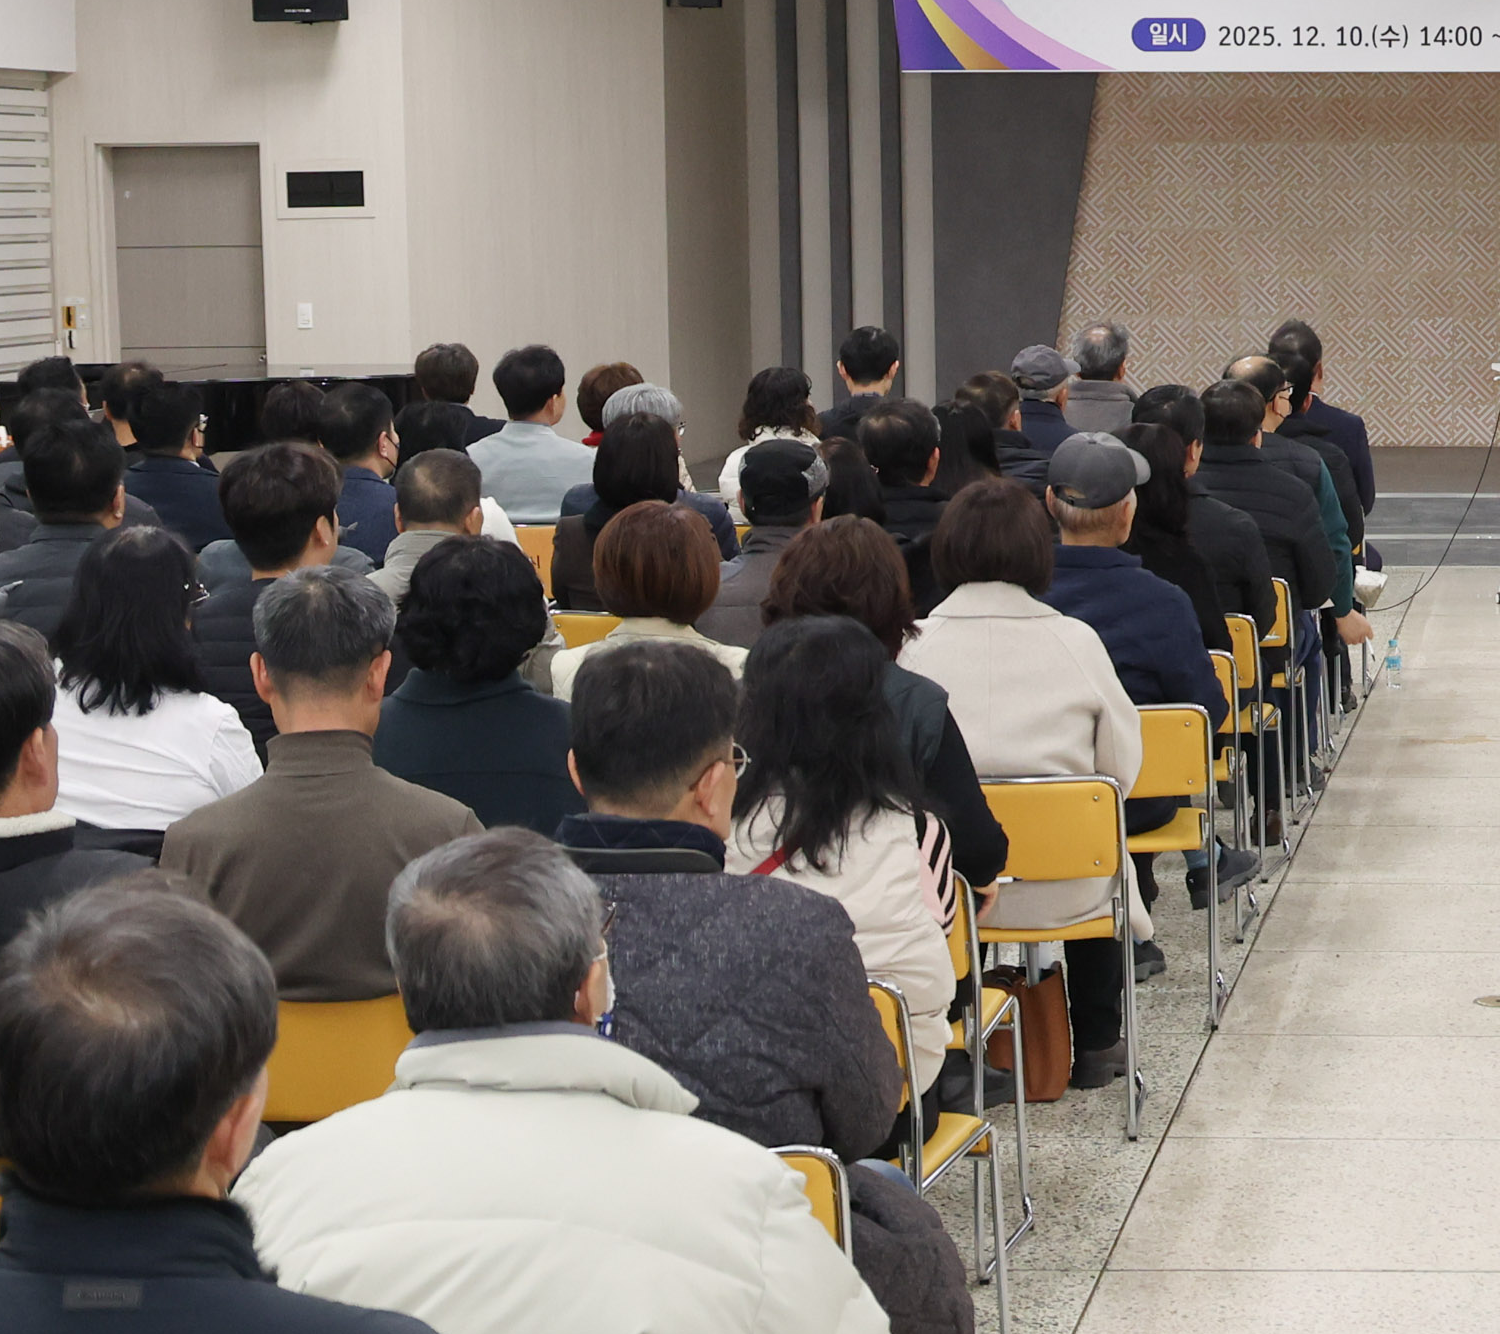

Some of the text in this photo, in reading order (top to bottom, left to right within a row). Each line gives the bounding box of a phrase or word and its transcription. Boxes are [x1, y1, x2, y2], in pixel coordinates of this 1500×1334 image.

[1149, 22, 1188, 46] 일시
[1218, 25, 1282, 48] 2025.
[1292, 25, 1326, 48] 12.
[1336, 24, 1409, 49] 10.(수)
[1420, 25, 1483, 47] 14:00
